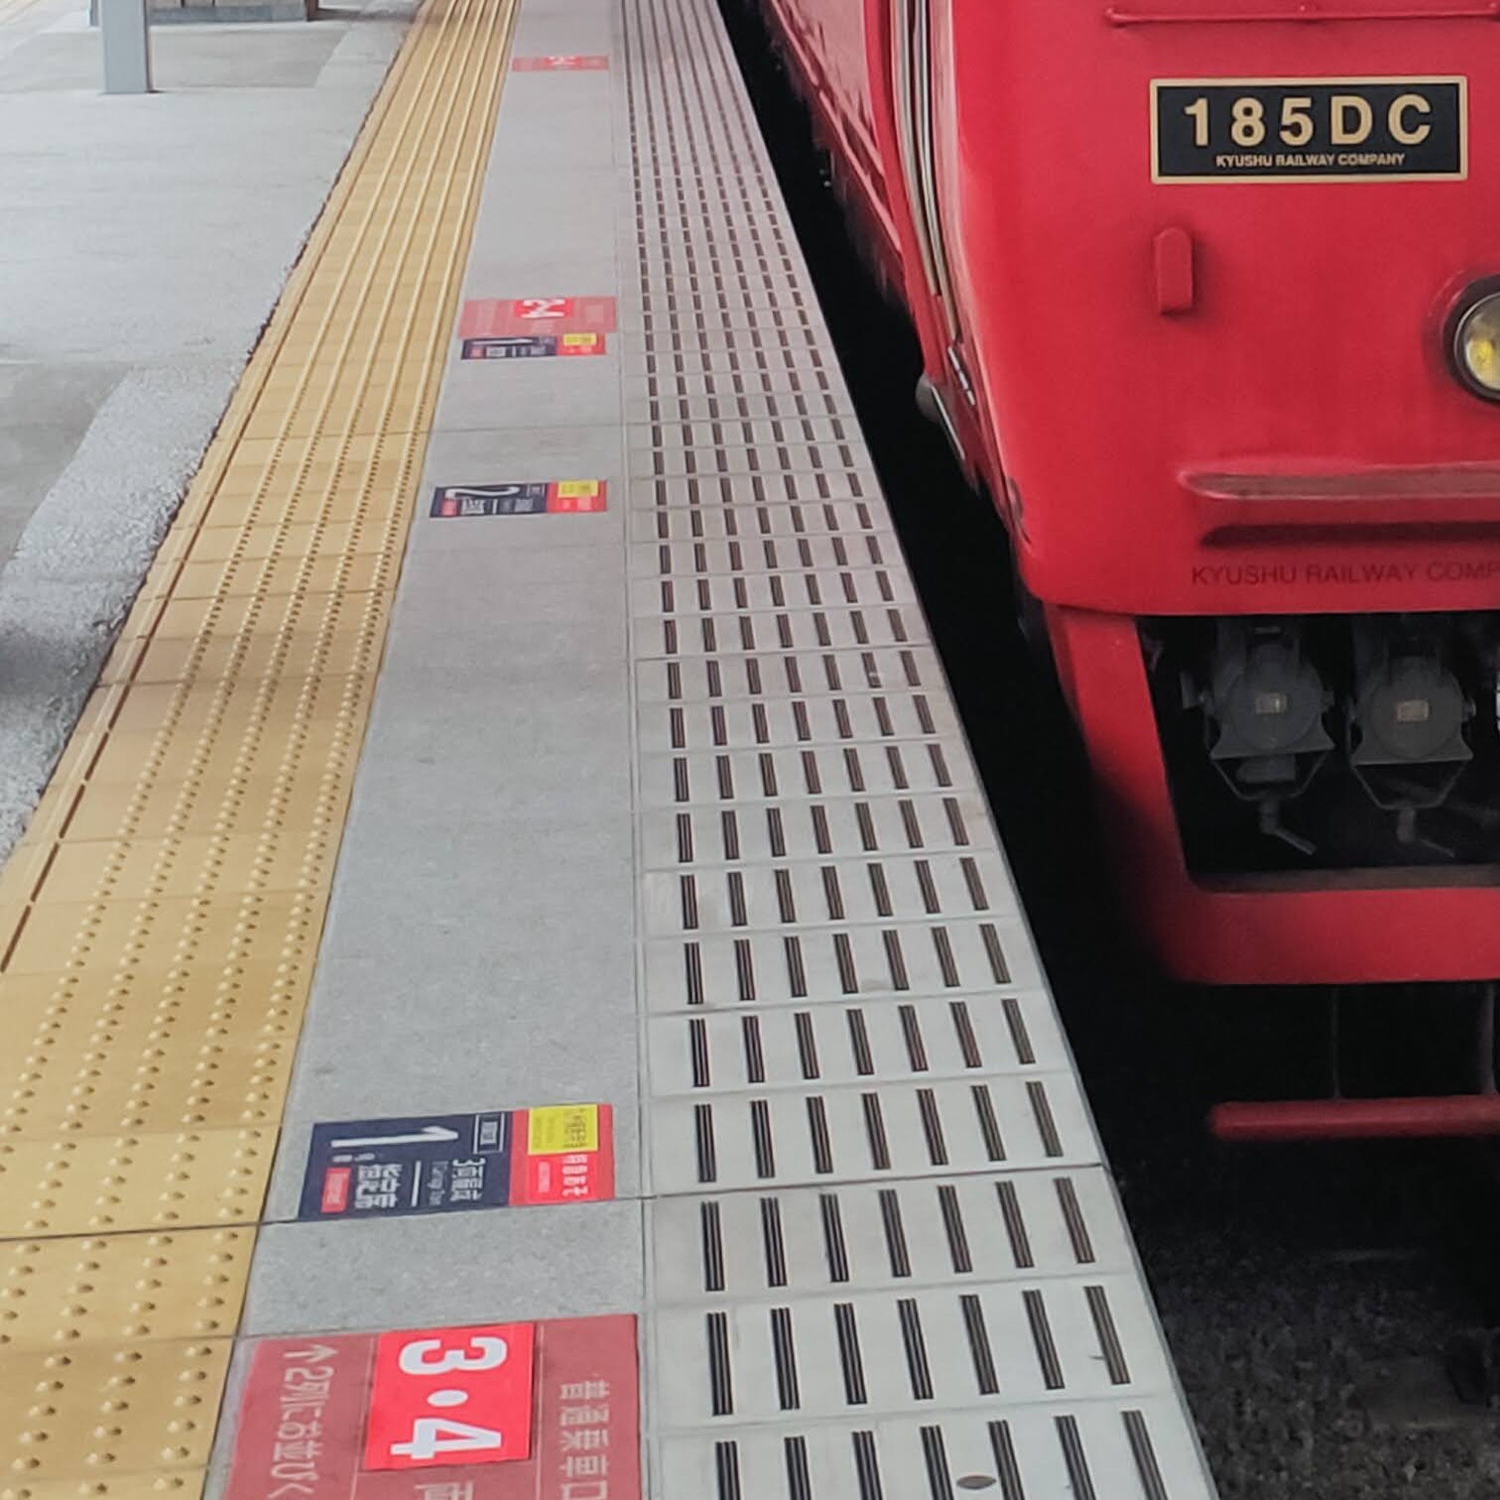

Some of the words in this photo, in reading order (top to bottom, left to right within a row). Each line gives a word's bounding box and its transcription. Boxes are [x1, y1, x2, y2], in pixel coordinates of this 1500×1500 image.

[1184, 93, 1432, 147] 185DC
[1216, 154, 1273, 168] KYUSHU
[1276, 153, 1335, 167] RAILWAY
[1338, 152, 1405, 167] COMPANY
[1191, 564, 1296, 586] KYUSHU
[1306, 562, 1419, 585] RAILWAY
